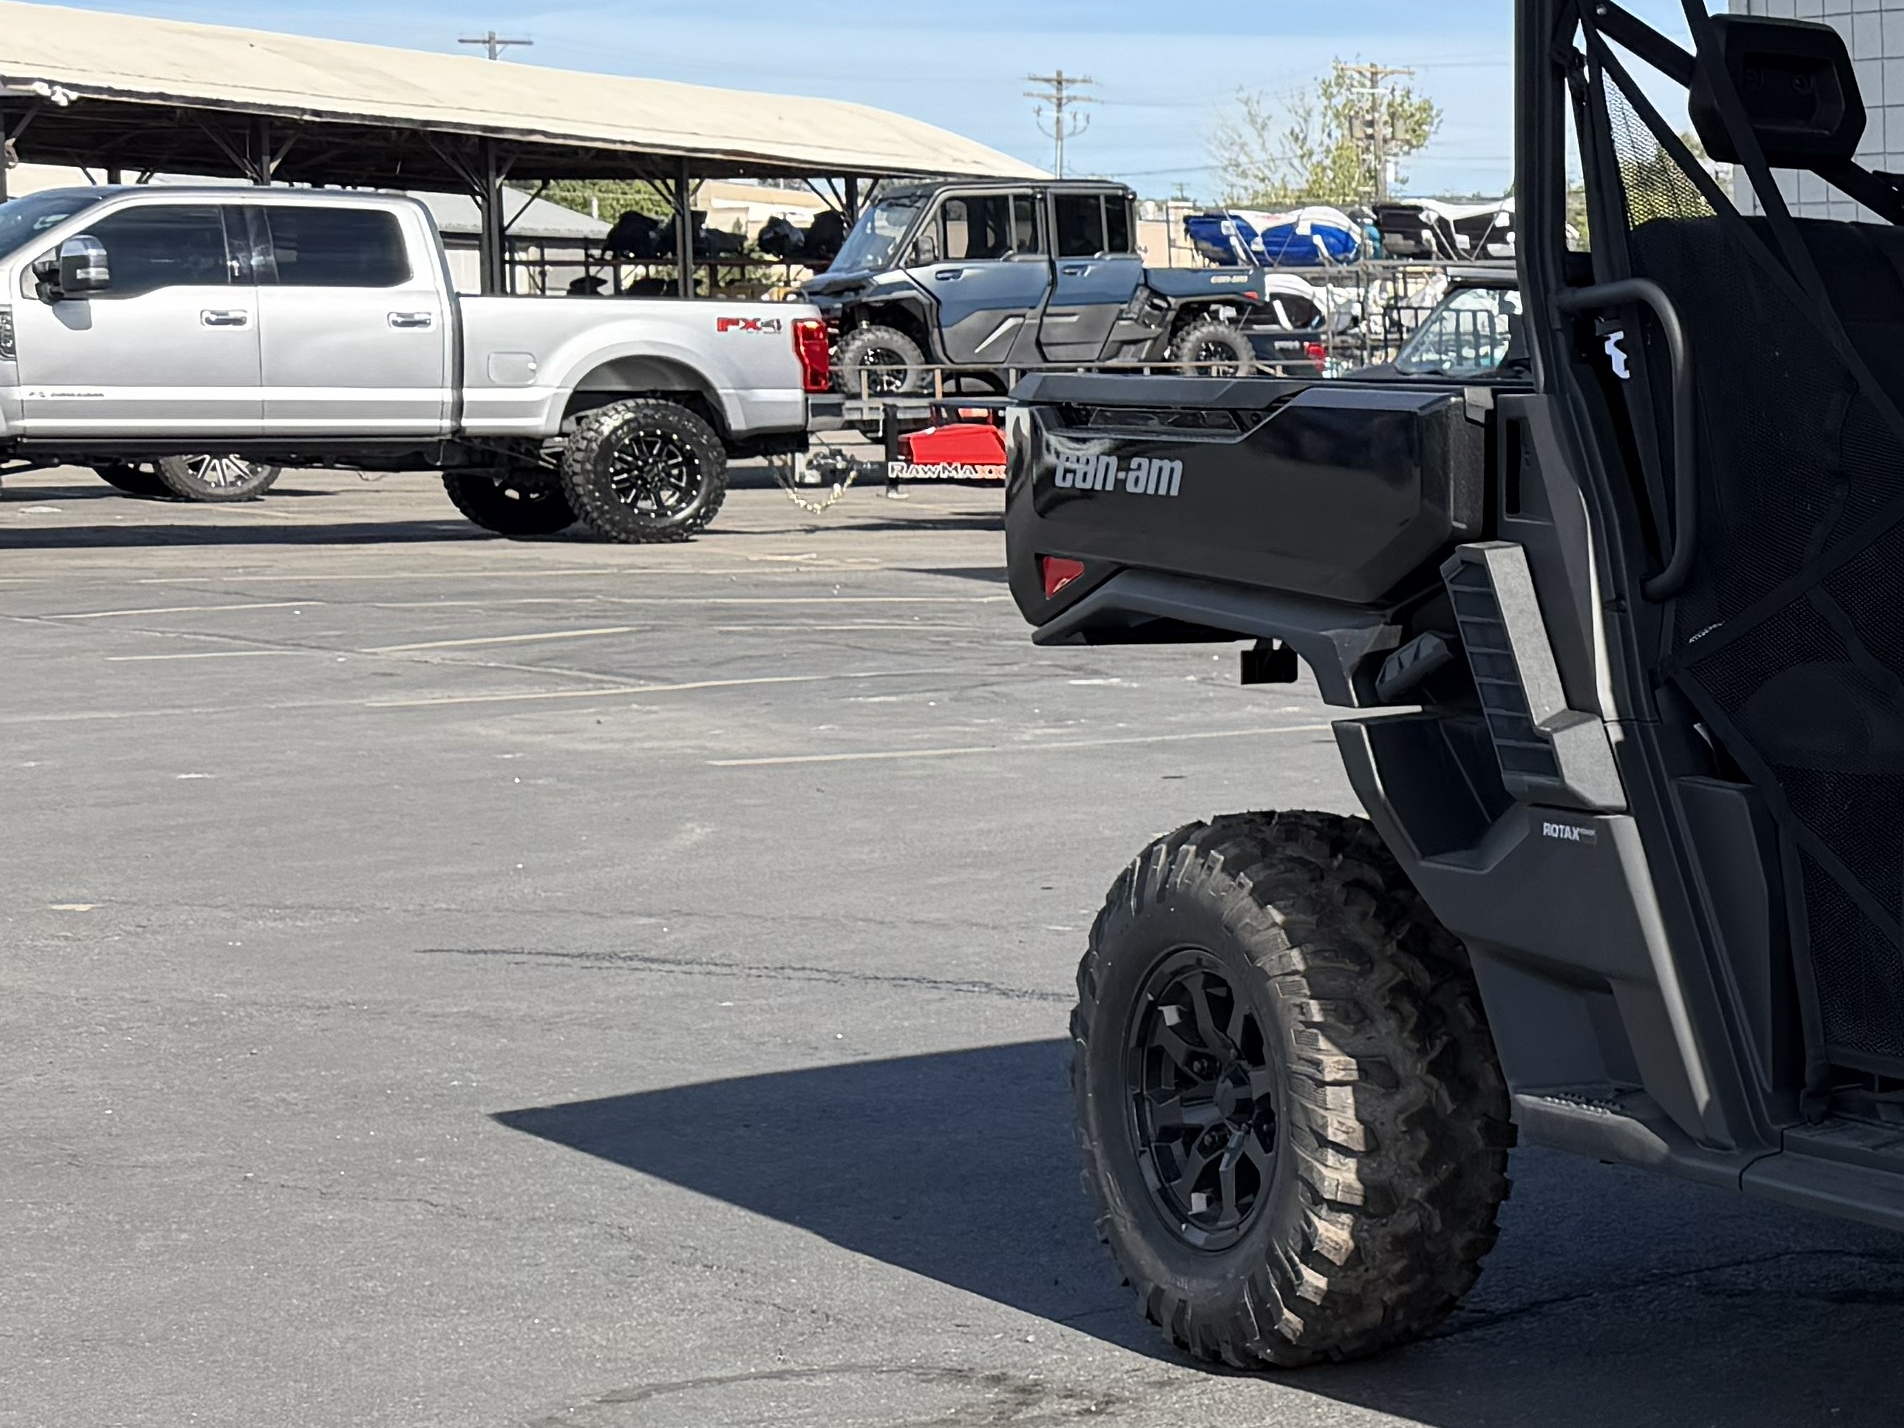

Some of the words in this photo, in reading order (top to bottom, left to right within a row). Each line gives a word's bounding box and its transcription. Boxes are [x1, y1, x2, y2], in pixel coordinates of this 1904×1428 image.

[716, 317, 782, 334] FX4
[1054, 453, 1184, 496] can-am
[1543, 822, 1580, 841] ROTAX
